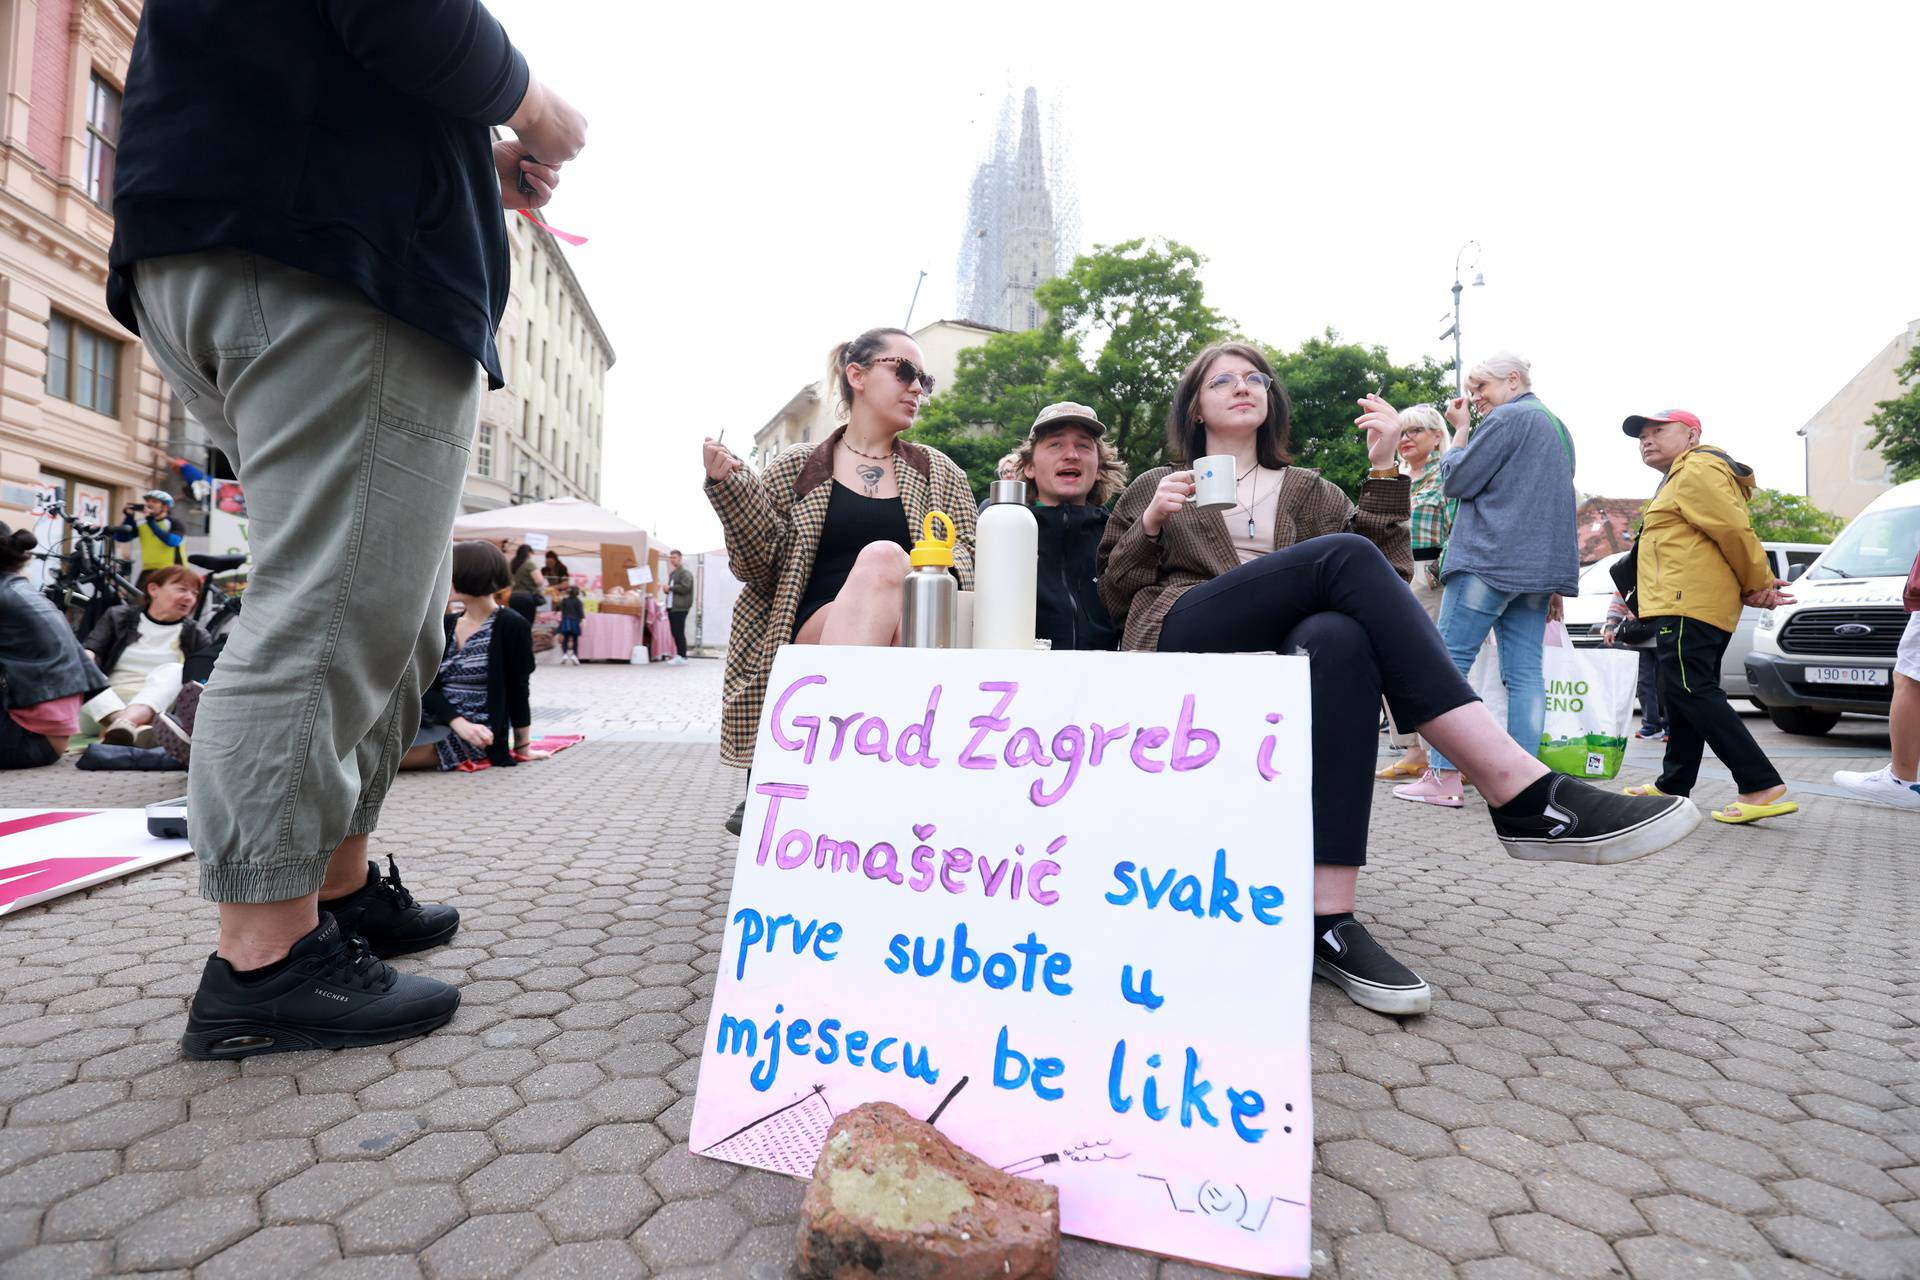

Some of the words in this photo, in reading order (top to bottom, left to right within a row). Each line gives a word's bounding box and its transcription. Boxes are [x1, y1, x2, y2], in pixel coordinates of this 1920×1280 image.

[1817, 668, 1840, 681] 190
[1850, 669, 1876, 682] 012
[770, 674, 942, 769] Grad
[958, 681, 1221, 808] Zagreb
[1256, 712, 1284, 782] i
[755, 782, 1068, 906] Tomašević
[1104, 848, 1285, 926] svake
[314, 988, 350, 1003] SKECHERS
[733, 907, 843, 981] prve
[884, 921, 1073, 997] subote
[1120, 964, 1165, 1012] u
[716, 1003, 940, 1092] mjesecu
[993, 1024, 1065, 1102] be
[1108, 1039, 1294, 1144] like:
